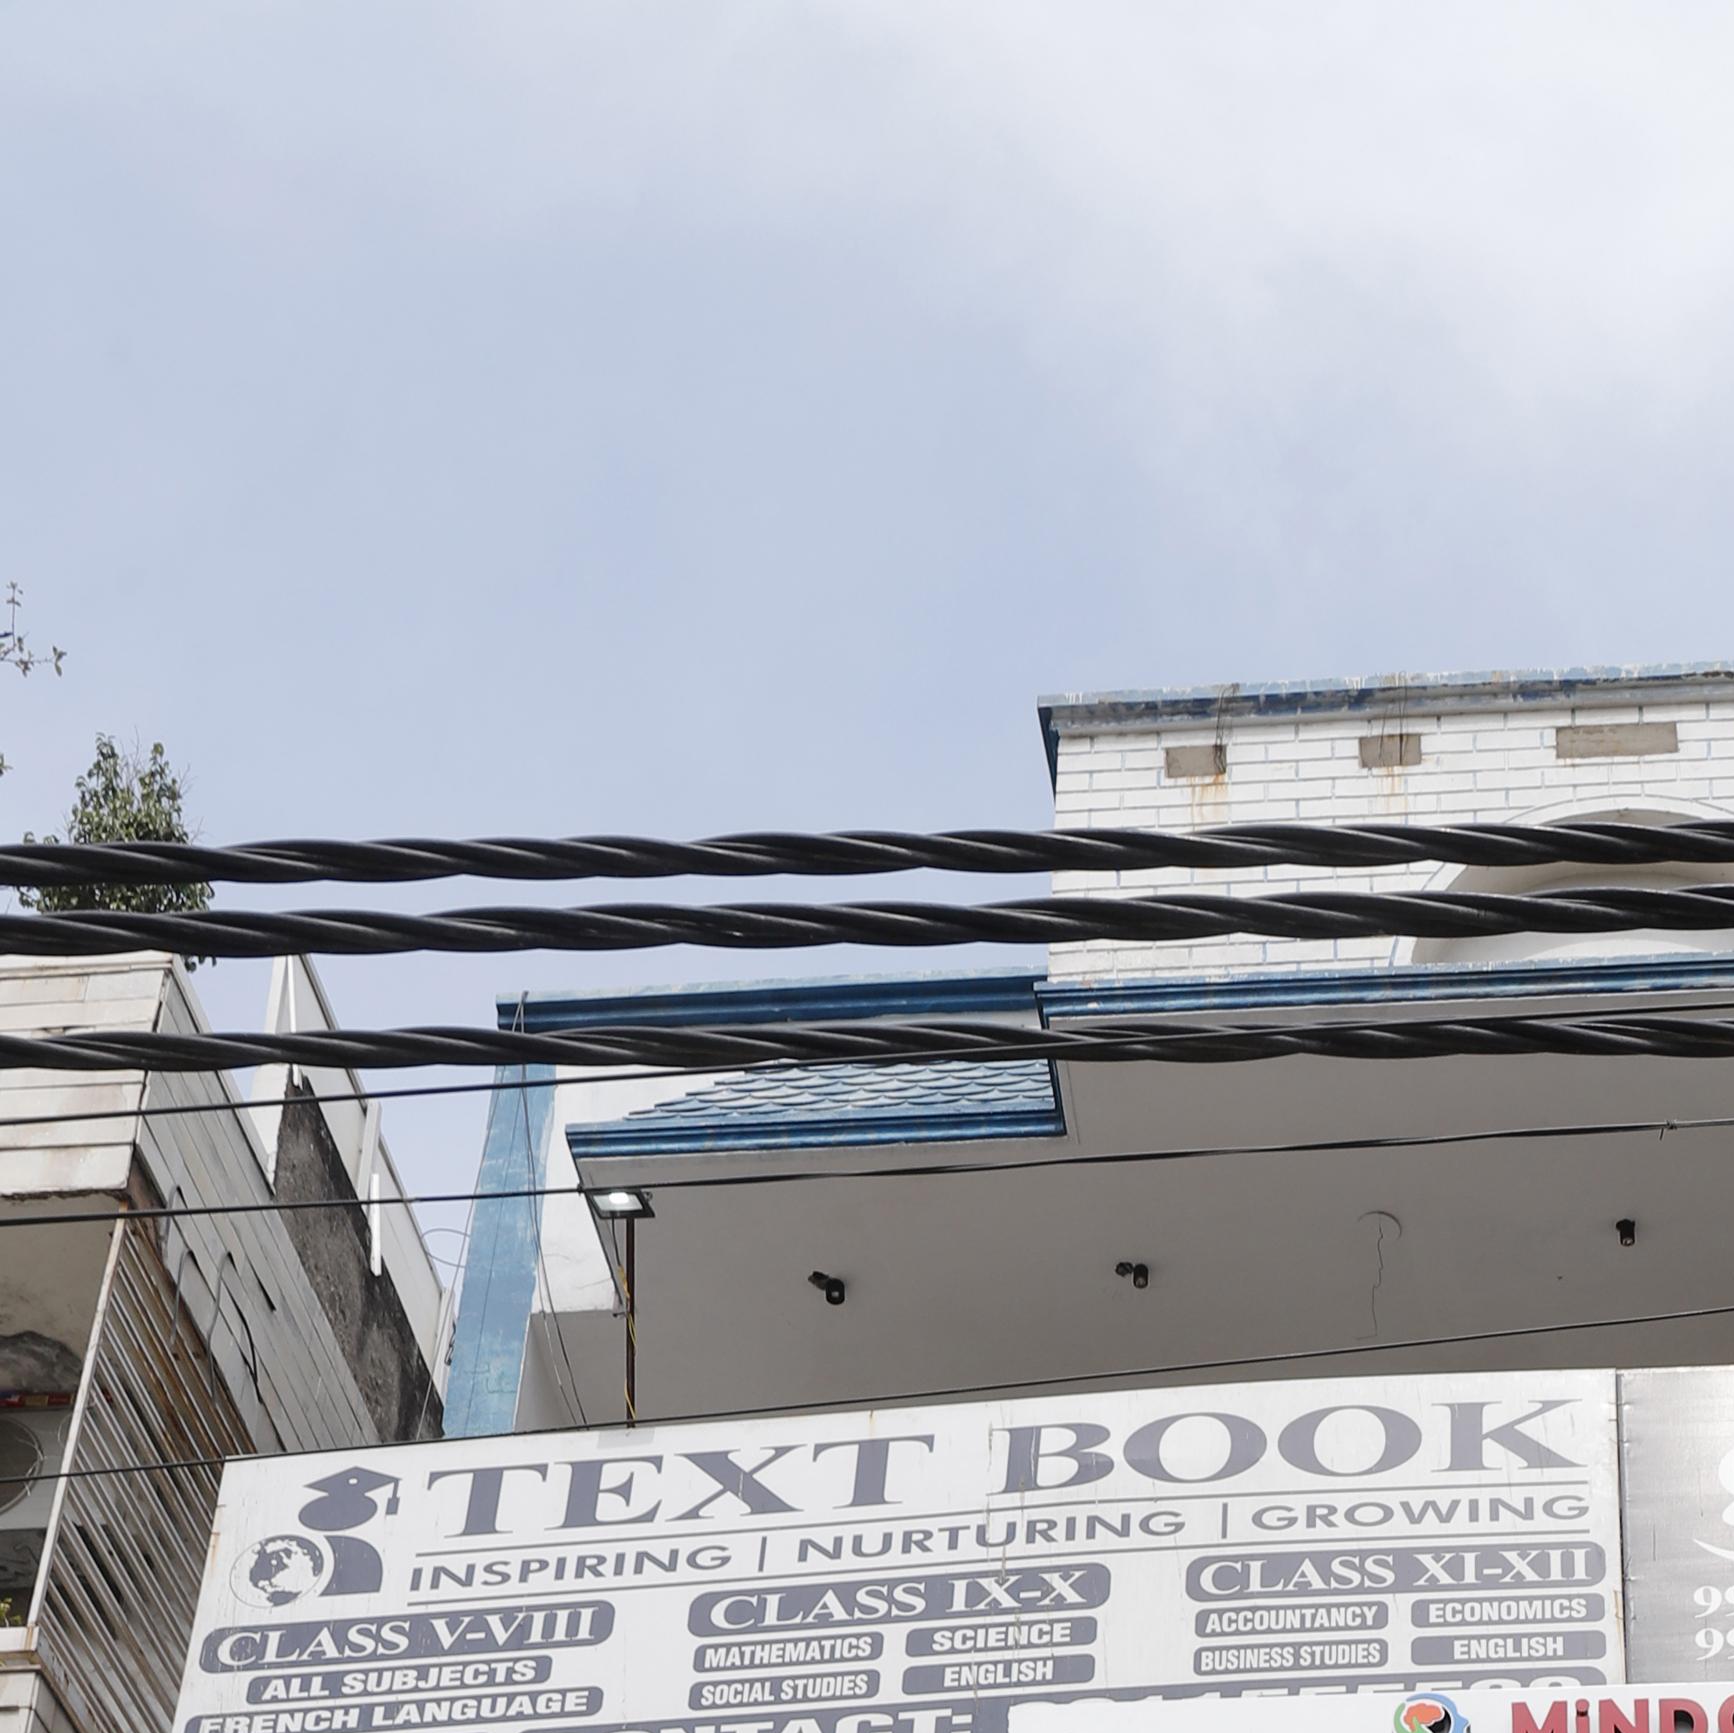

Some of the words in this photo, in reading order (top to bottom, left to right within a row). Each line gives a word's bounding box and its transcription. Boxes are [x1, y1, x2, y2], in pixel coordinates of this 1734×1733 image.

[427, 1435, 934, 1537] TEXT
[995, 1398, 1588, 1494] BOOK
[410, 1543, 730, 1591] INSPIRING
[798, 1509, 1185, 1563] NURTURING
[1251, 1496, 1589, 1531] GROWING
[1200, 1555, 1395, 1595] CLASS
[1414, 1548, 1594, 1588] XI-XII
[710, 1579, 929, 1630] CLASS
[948, 1570, 1089, 1614] IX-X
[1428, 1599, 1588, 1622] ECONOMICS
[1205, 1605, 1378, 1632] ACCOUNTANCY
[216, 1623, 410, 1667] CLASS
[430, 1607, 595, 1652] V-VIII
[703, 1635, 872, 1668] MATHEMATICS
[933, 1621, 1071, 1651] SCIENCE
[1453, 1637, 1564, 1660] ENGLISH
[1200, 1646, 1297, 1671] BUSINESS
[1300, 1642, 1381, 1666] STUDIES
[262, 1670, 335, 1701] ALL
[341, 1658, 536, 1694] SUBJECTS
[700, 1681, 776, 1706] SOCIAL
[780, 1674, 868, 1701] STUDIES
[943, 1659, 1054, 1688] ENGLISH
[370, 1690, 589, 1726] LANGUAGE
